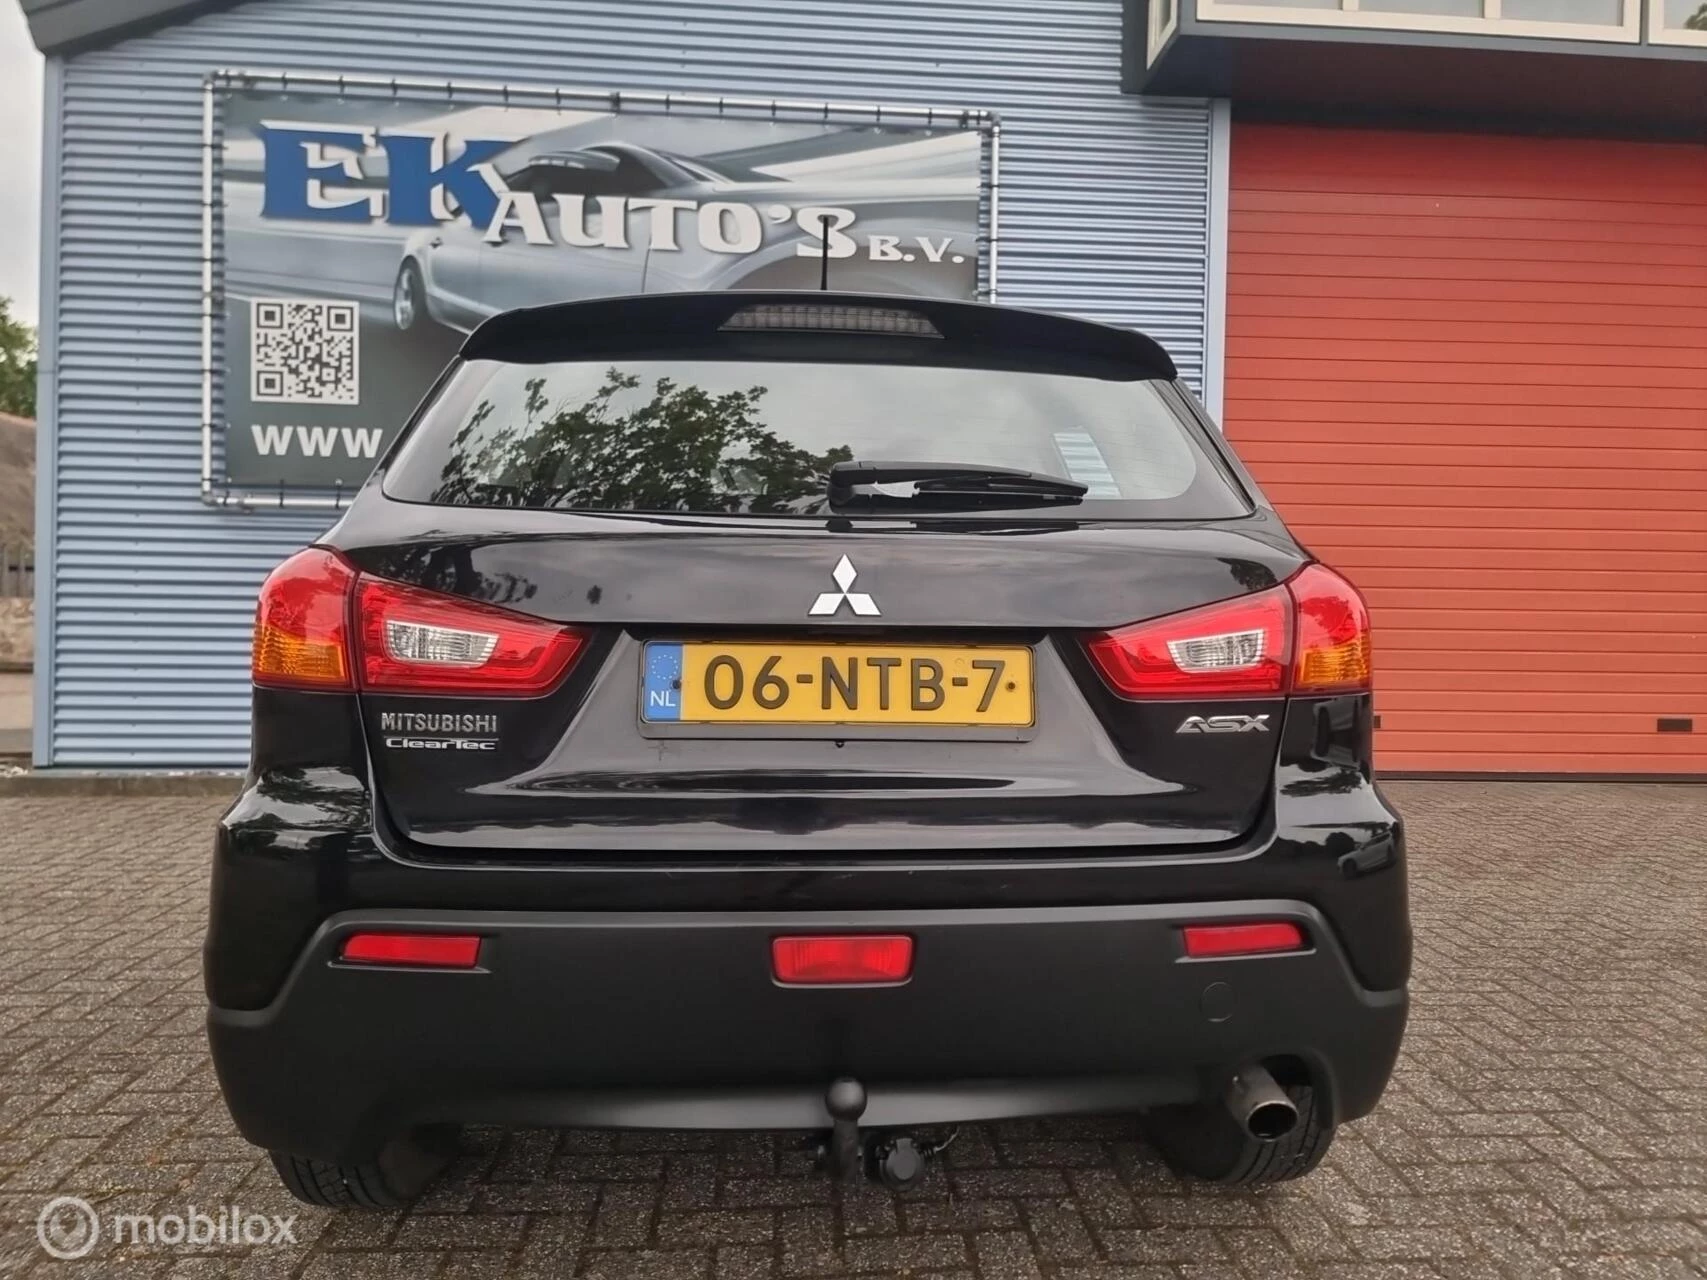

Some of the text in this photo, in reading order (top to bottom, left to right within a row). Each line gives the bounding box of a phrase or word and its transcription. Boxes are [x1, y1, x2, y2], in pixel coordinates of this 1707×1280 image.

[259, 119, 529, 231] EK
[868, 234, 965, 264] B.V.
[704, 655, 1006, 713] 06-NTB-7
[650, 690, 676, 708] NL
[381, 712, 498, 733] MITSUBISHI
[1175, 714, 1270, 733] ASX
[386, 738, 496, 750] ClearTec
